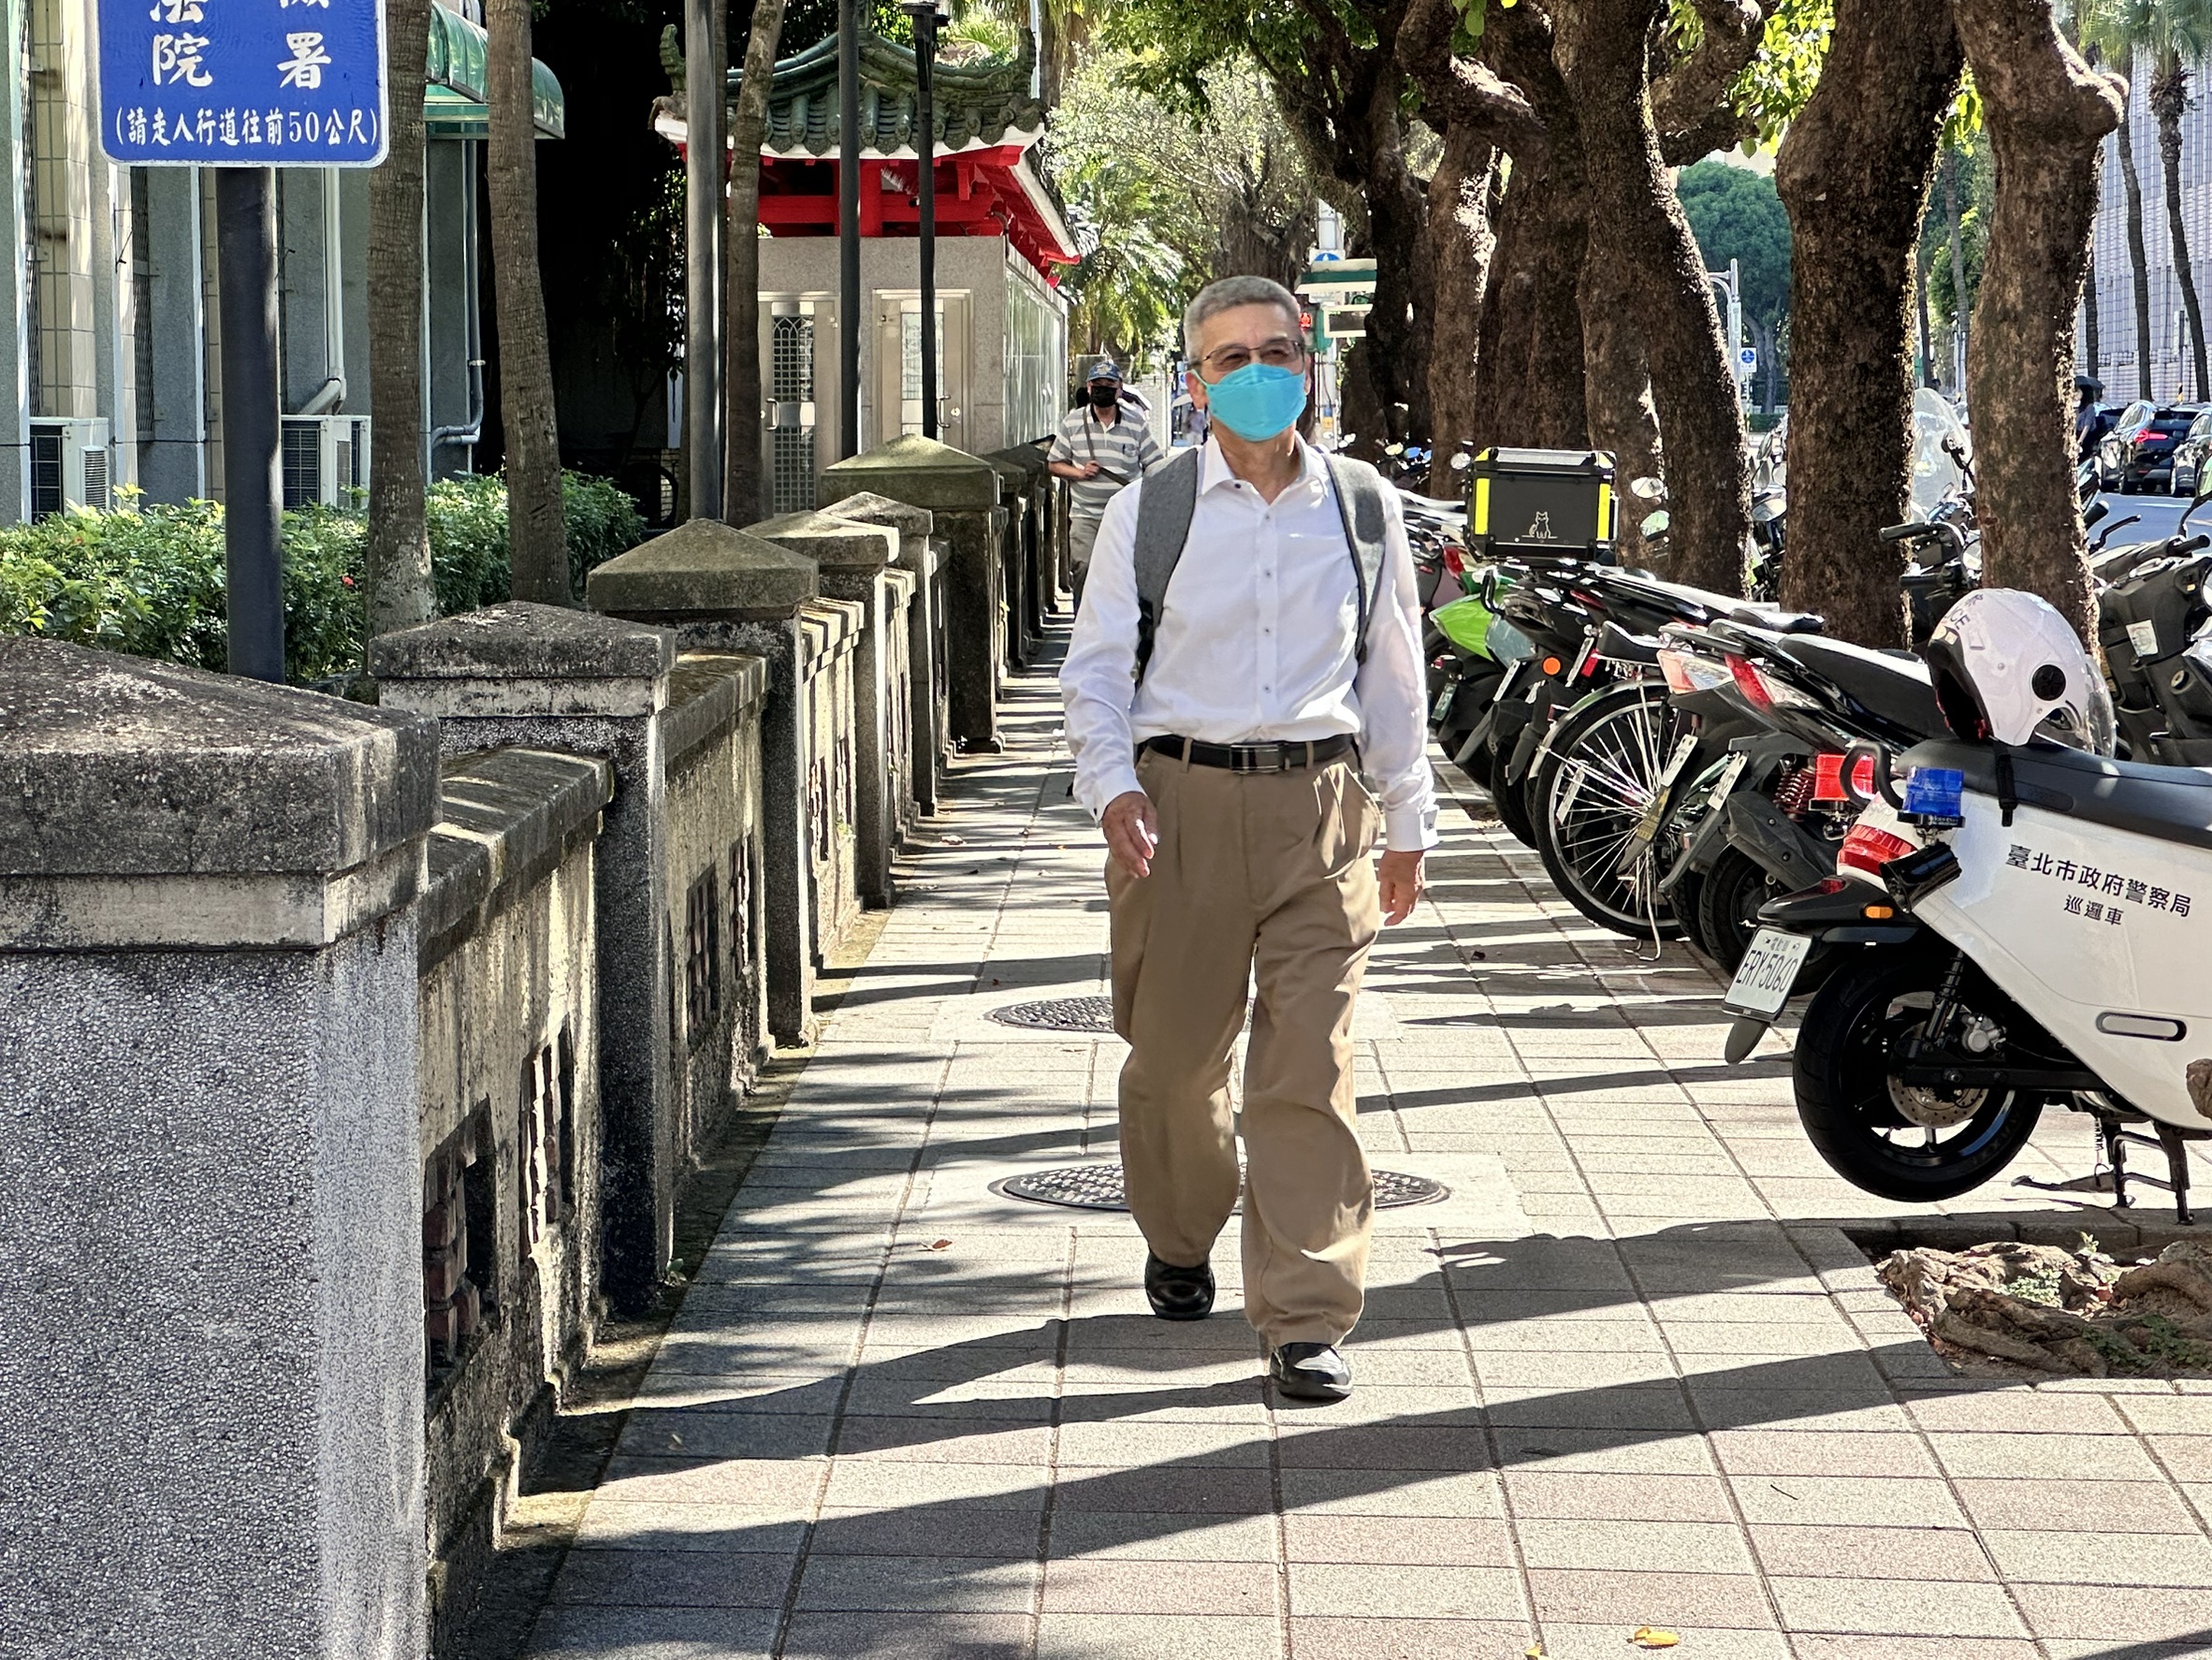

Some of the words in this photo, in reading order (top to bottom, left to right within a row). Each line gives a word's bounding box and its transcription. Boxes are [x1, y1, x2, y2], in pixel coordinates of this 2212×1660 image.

[115, 107, 378, 147] (請走人行道往前50公尺)
[2005, 843, 2192, 918] 臺北市政府警察局
[2063, 895, 2125, 926] 巡邏車
